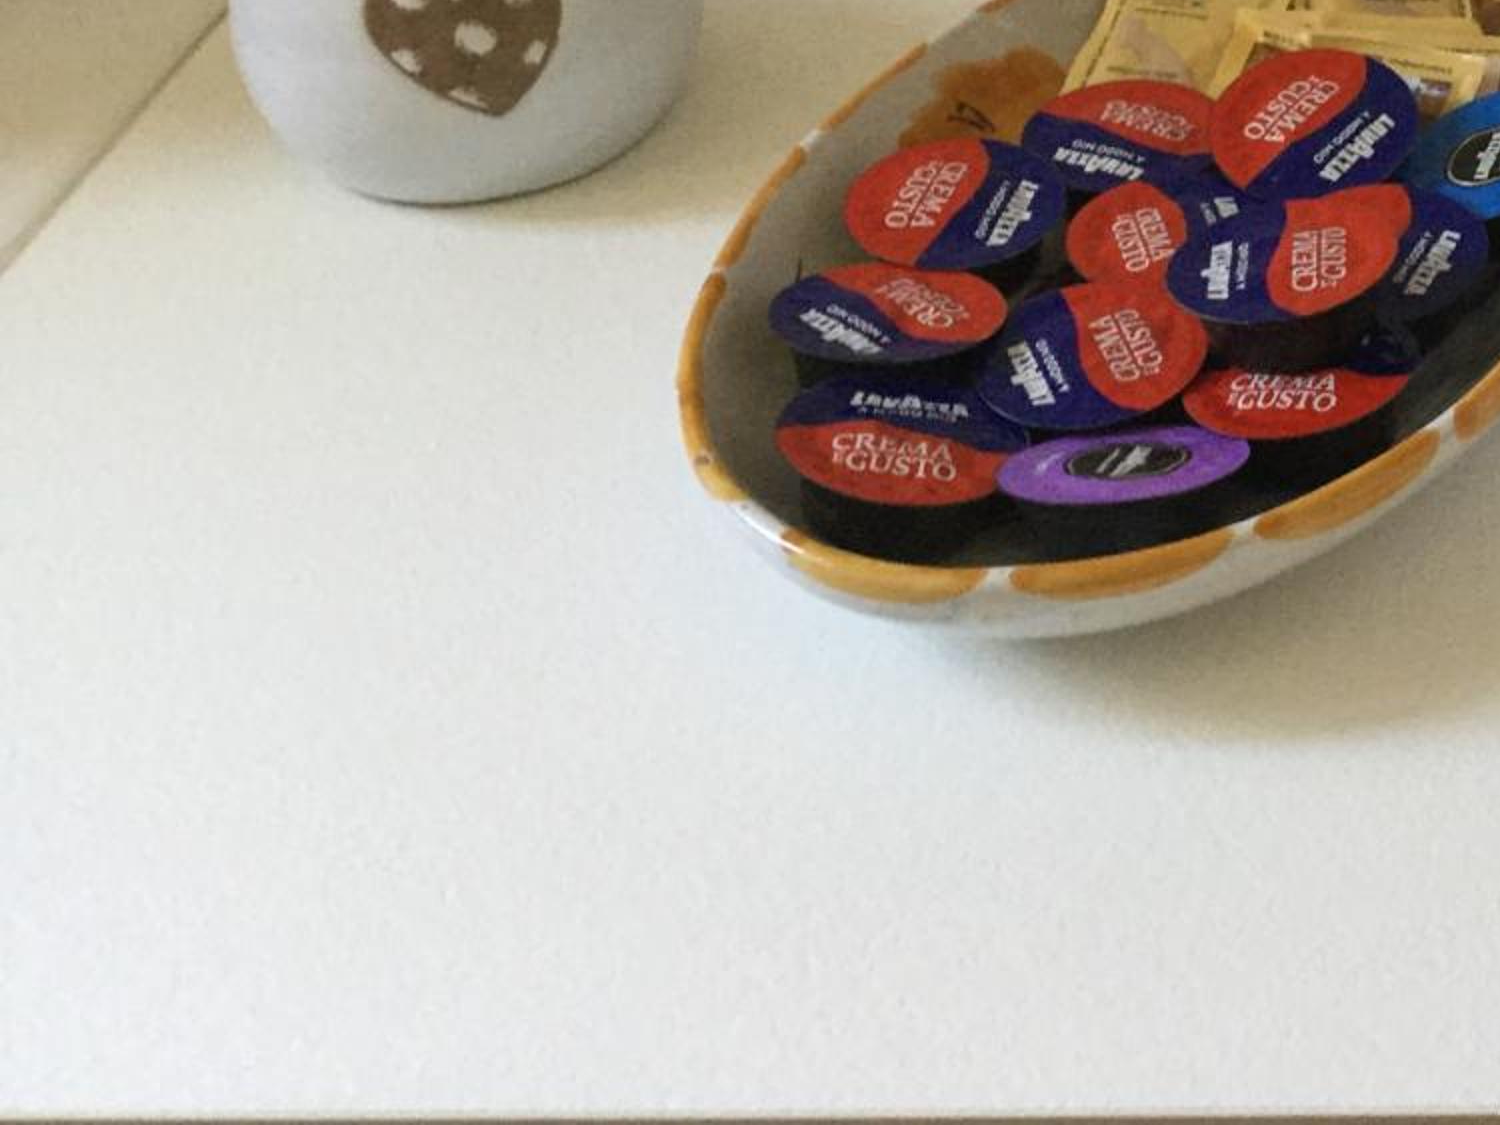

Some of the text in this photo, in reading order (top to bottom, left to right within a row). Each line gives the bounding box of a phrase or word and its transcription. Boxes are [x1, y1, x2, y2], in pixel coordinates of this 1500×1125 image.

[1243, 80, 1311, 140] GUSTO
[1264, 80, 1340, 143] CREMA
[1319, 112, 1396, 182] LAVAZZA
[884, 164, 938, 229] GUSTO
[910, 161, 969, 229] CREMA
[1292, 231, 1317, 291] CREMA
[1088, 315, 1140, 382] CREMA
[1114, 309, 1163, 368] GUSTO
[1237, 389, 1338, 412] GUSTO
[832, 432, 952, 465] CREMA
[845, 450, 957, 482] GUSTO
